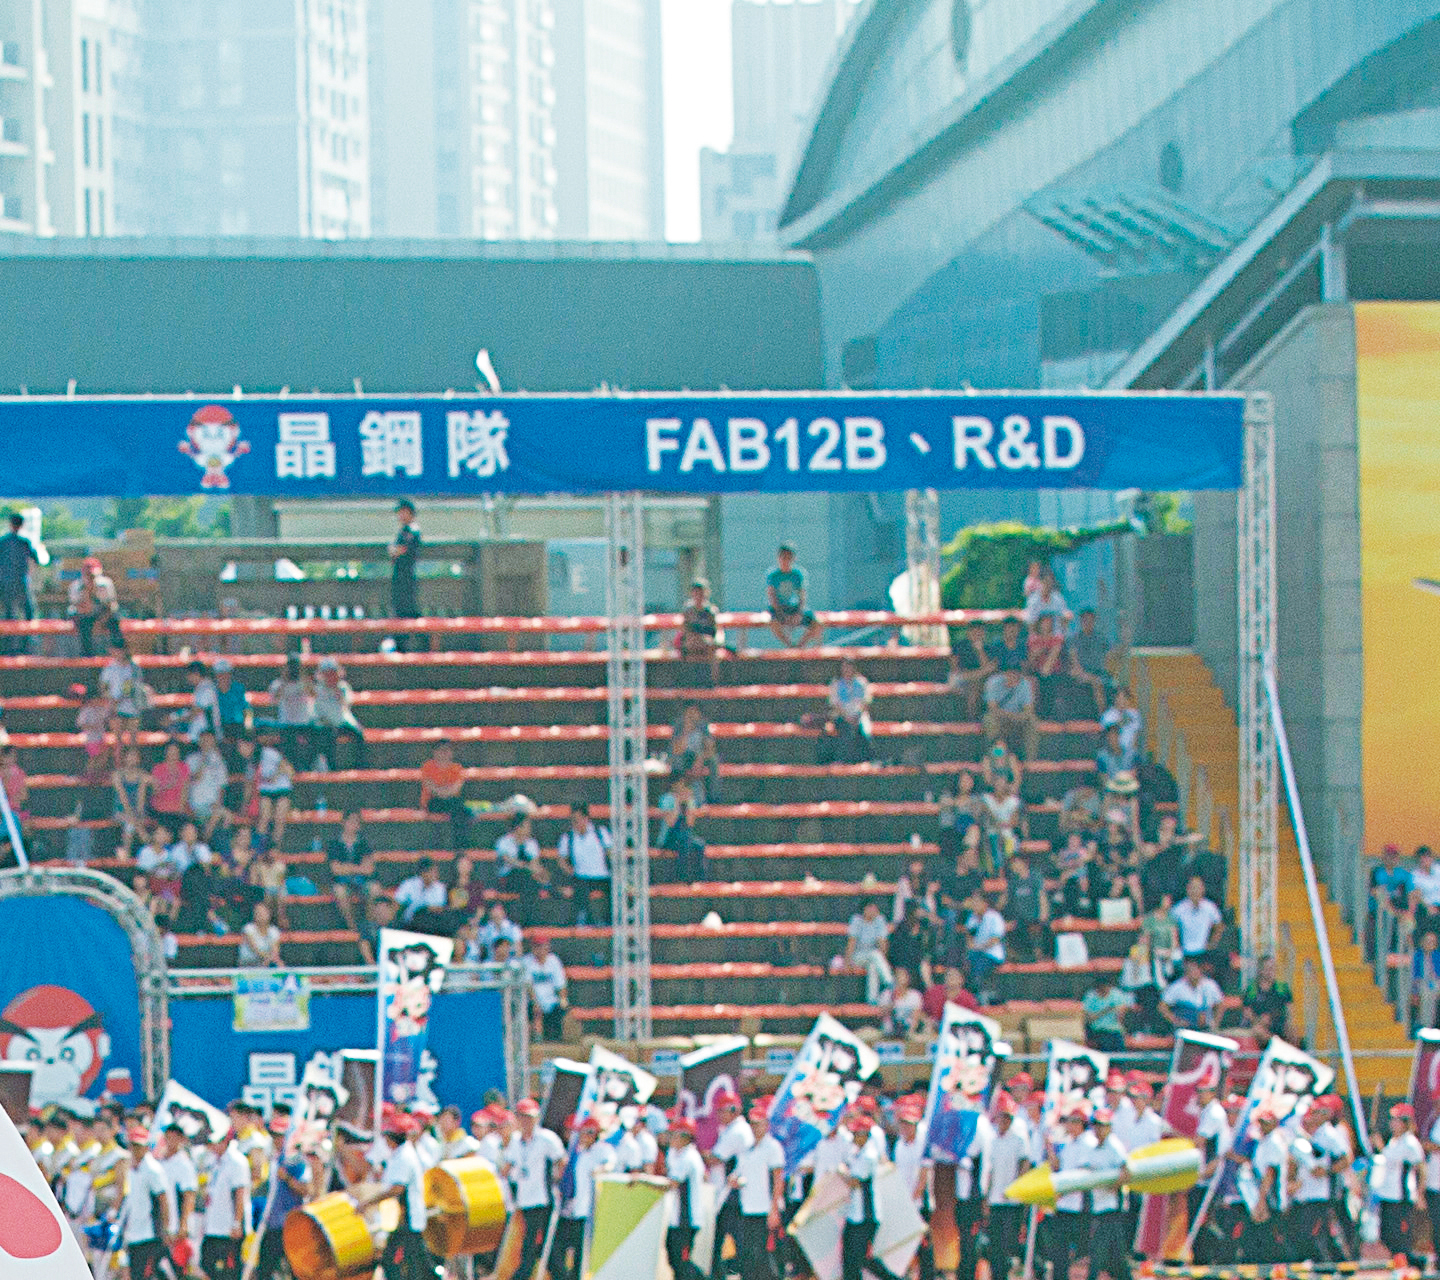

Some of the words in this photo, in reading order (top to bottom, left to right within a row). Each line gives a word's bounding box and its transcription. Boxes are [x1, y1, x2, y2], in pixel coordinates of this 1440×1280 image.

[274, 409, 510, 479] 晶鋼隊
[951, 414, 1086, 471] R&D
